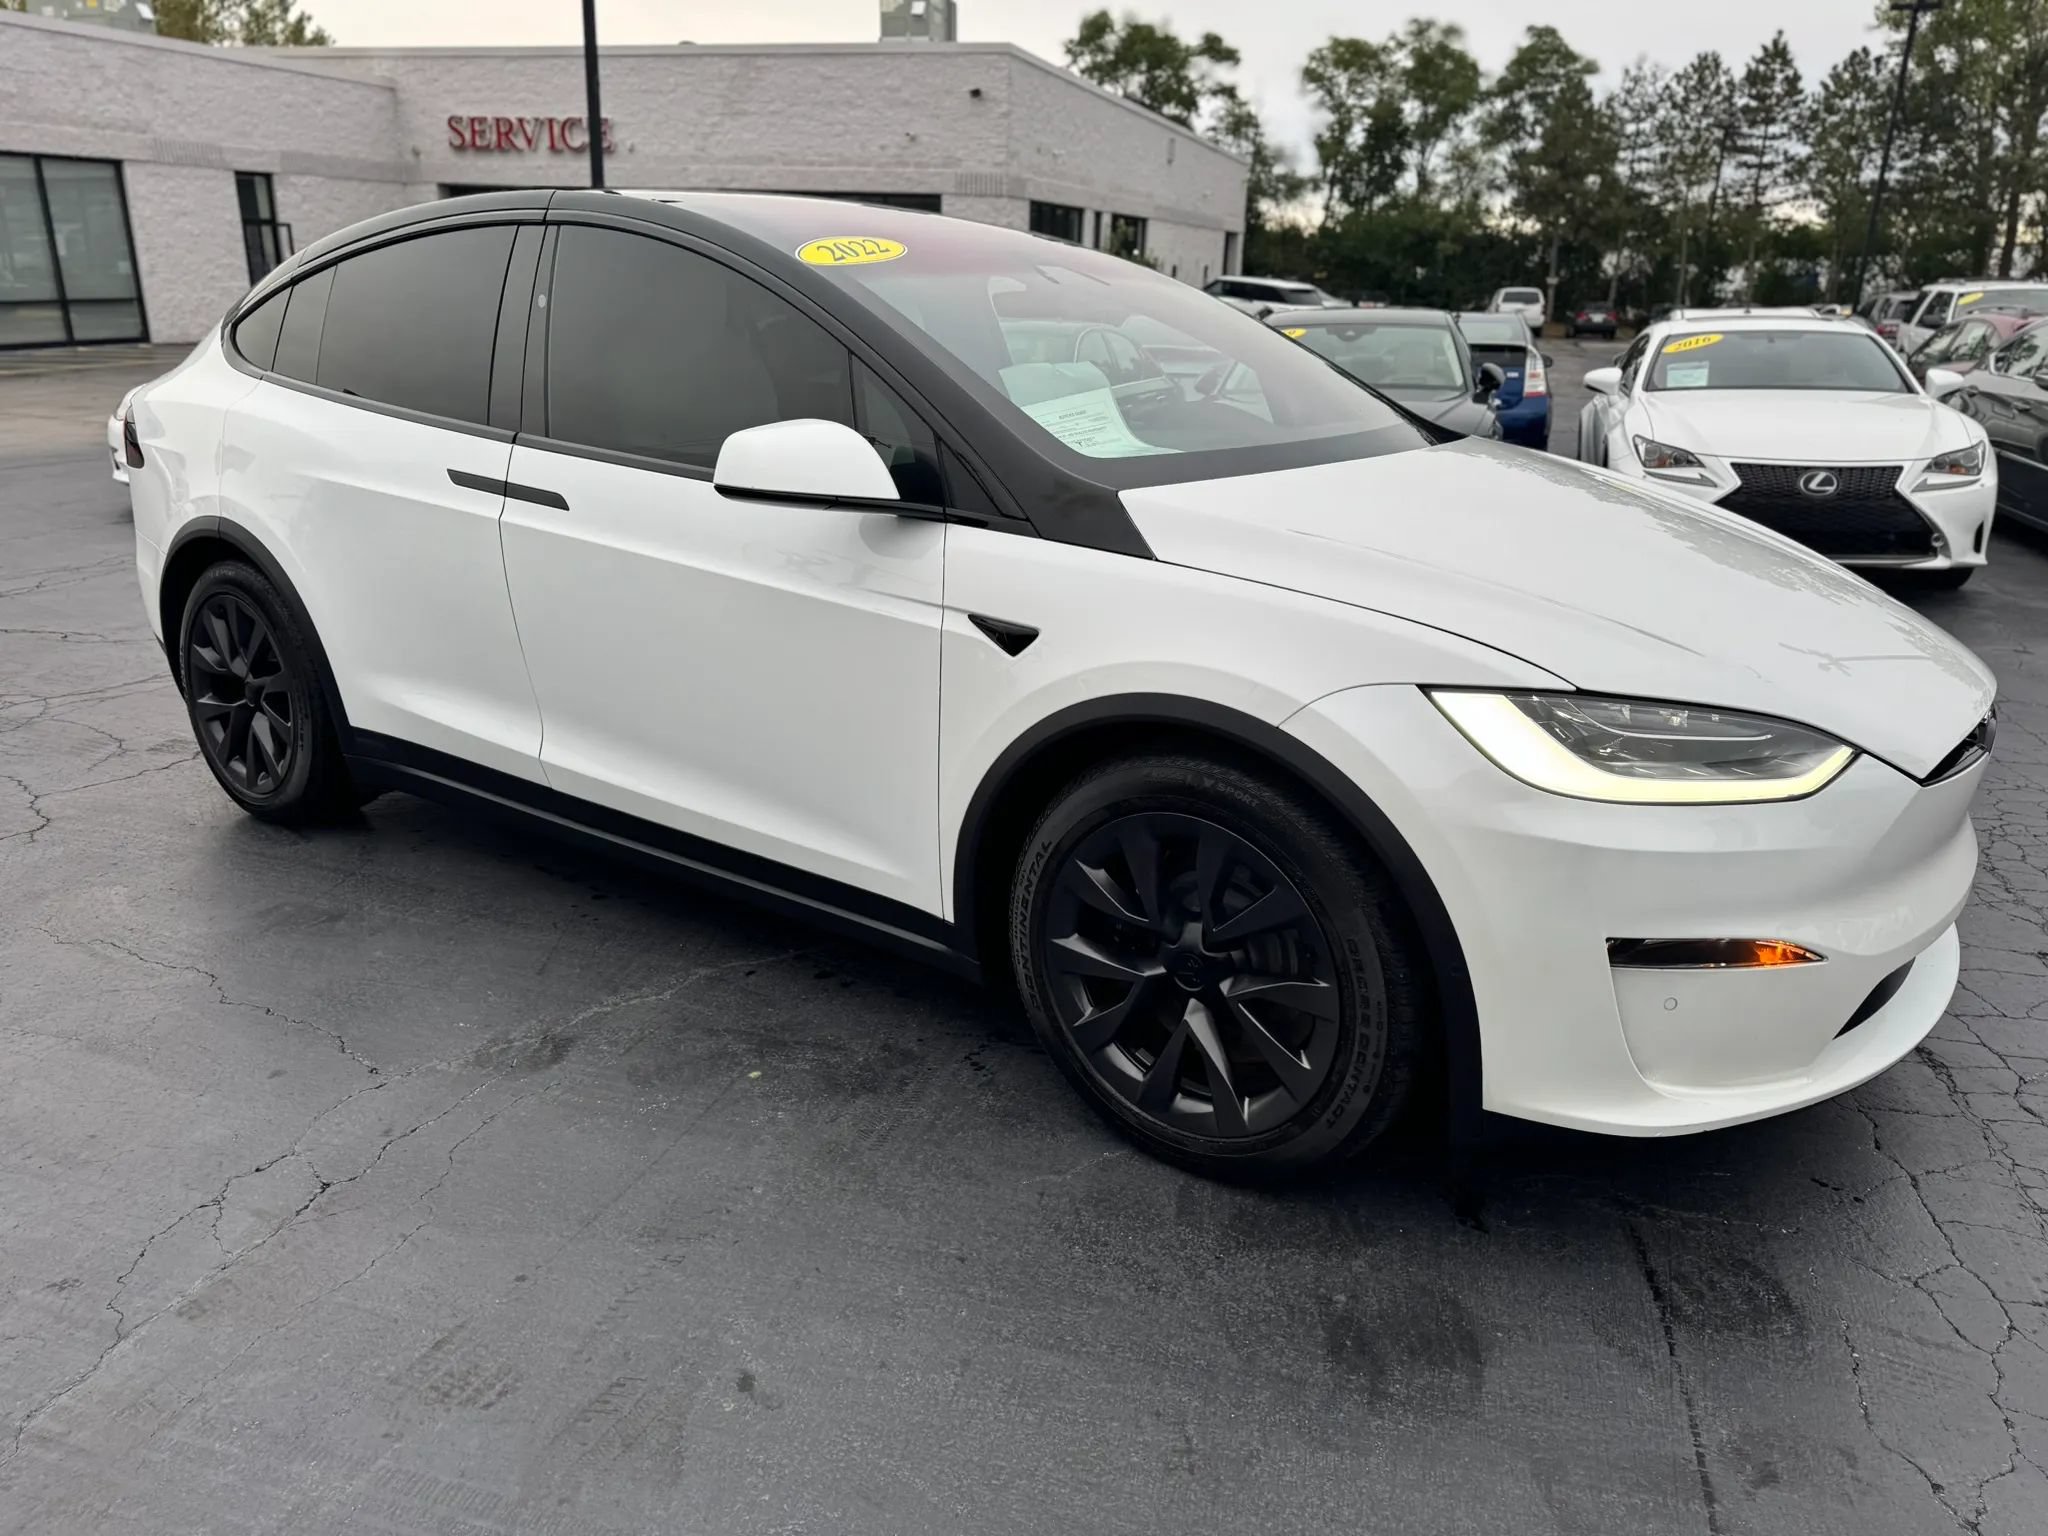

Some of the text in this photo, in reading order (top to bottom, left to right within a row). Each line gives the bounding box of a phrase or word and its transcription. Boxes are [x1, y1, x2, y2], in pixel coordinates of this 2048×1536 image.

[447, 115, 615, 151] SERVICE
[816, 239, 890, 262] 2022
[1675, 336, 1711, 351] 2016
